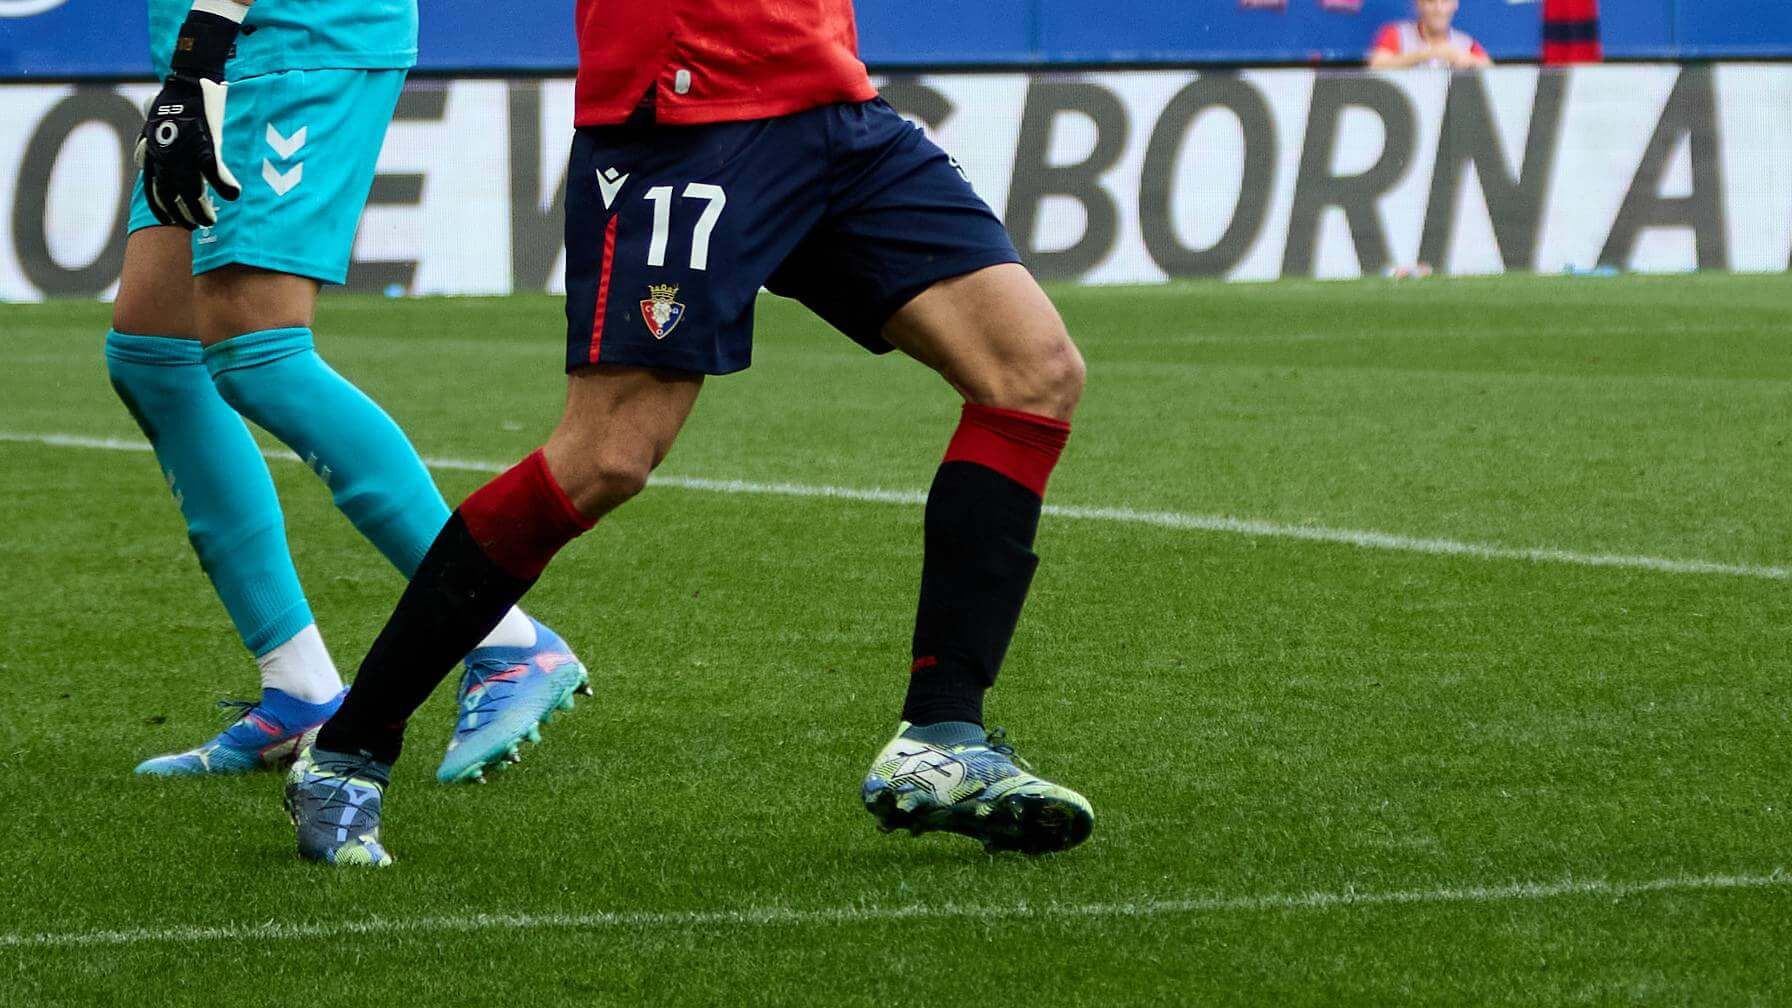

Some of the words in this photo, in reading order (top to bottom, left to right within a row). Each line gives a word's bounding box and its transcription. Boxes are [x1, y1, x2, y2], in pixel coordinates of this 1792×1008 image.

[643, 181, 727, 271] 17
[1005, 70, 1572, 282] BORN
[1595, 66, 1729, 274] A
